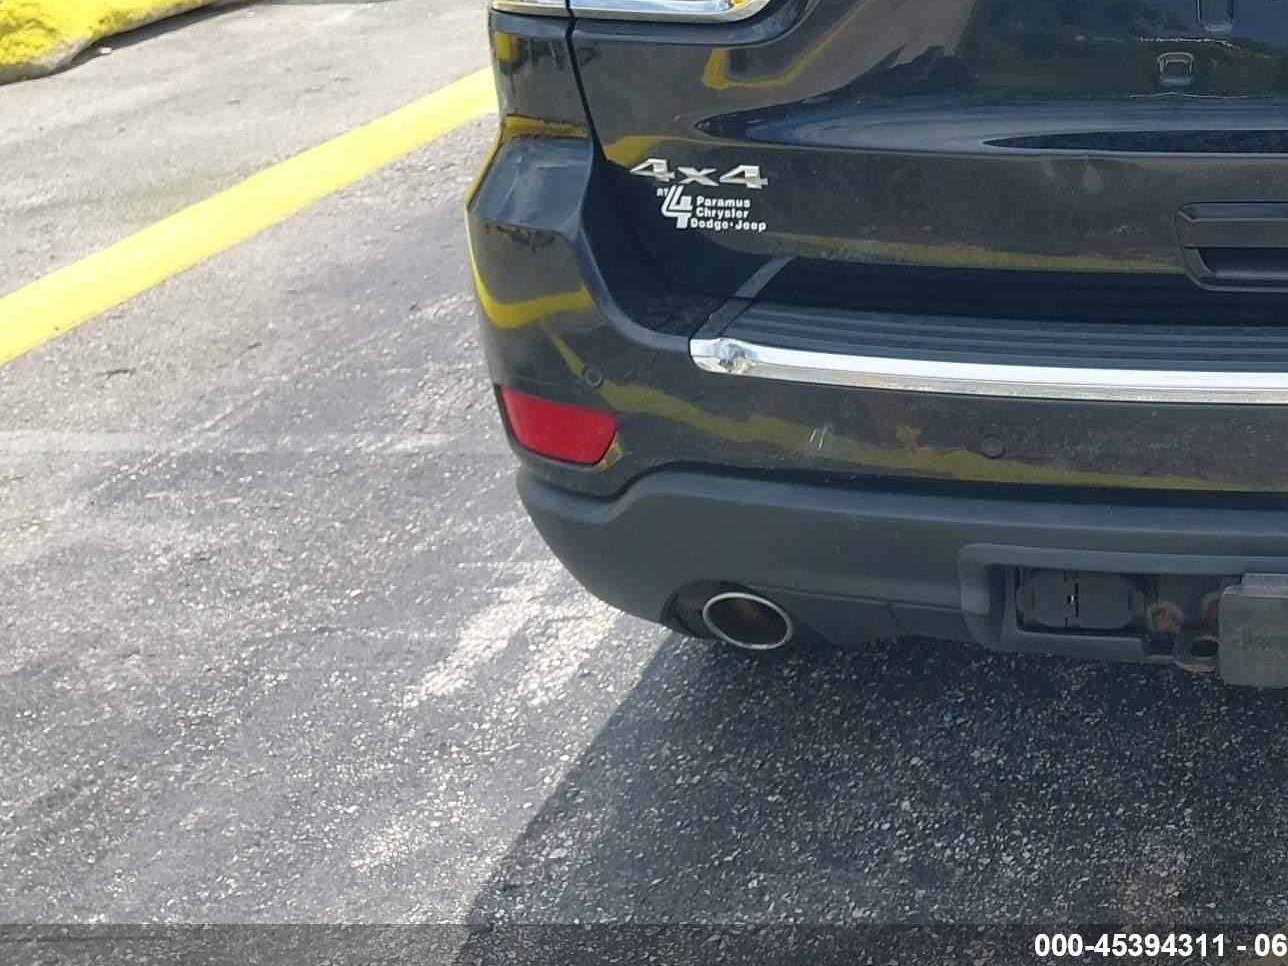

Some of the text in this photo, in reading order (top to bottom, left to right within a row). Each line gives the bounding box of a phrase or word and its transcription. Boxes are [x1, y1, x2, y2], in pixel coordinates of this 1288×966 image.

[629, 158, 769, 190] 4x4
[661, 185, 693, 229] 4
[696, 197, 751, 208] Paramus
[696, 207, 750, 220] Chrysler
